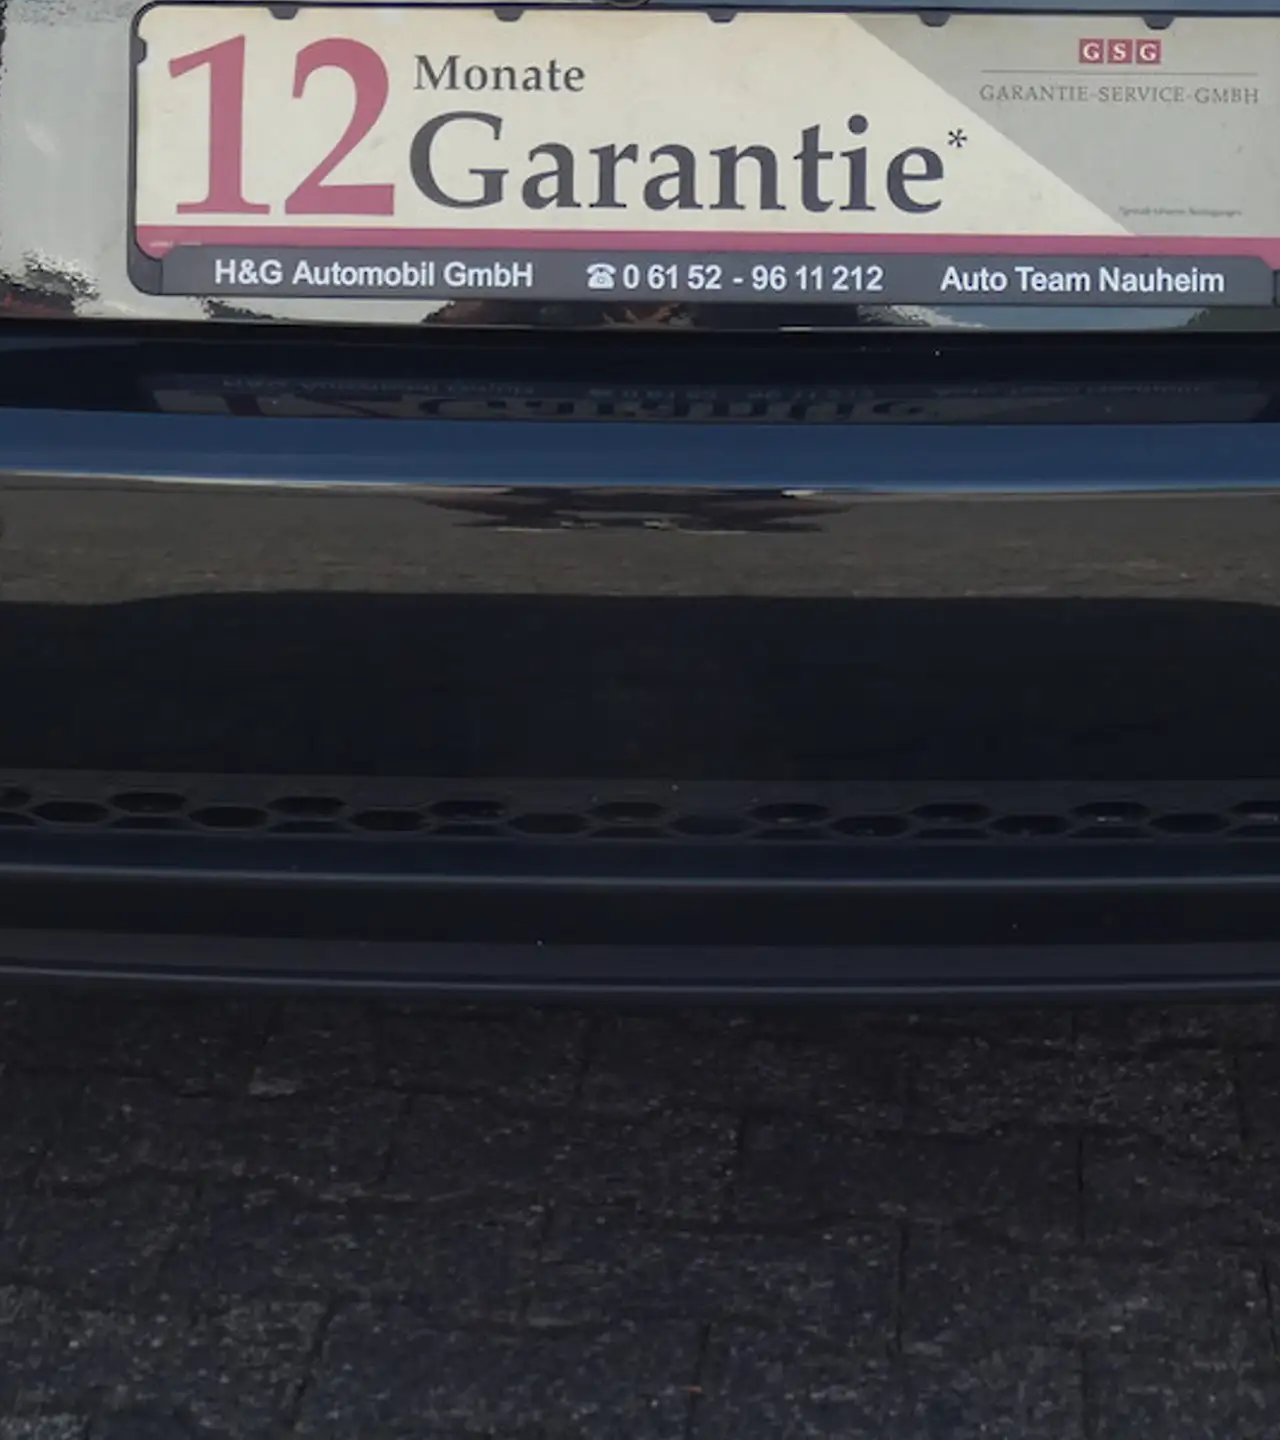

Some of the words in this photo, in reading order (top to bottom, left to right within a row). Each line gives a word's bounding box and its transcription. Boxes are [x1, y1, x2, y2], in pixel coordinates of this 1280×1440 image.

[1080, 40, 1161, 63] GSG
[413, 54, 587, 93] Monate
[168, 34, 396, 216] 12
[214, 260, 284, 287] H&G
[291, 260, 436, 288] Automobil
[442, 262, 534, 288] GmbH
[622, 265, 640, 291] 0
[646, 265, 679, 291] 61
[686, 265, 723, 291] 52
[751, 265, 788, 291] 96
[831, 266, 884, 292] 212
[939, 267, 1008, 292] Auto
[1014, 267, 1092, 293] Team
[1098, 267, 1226, 293] Nauheim
